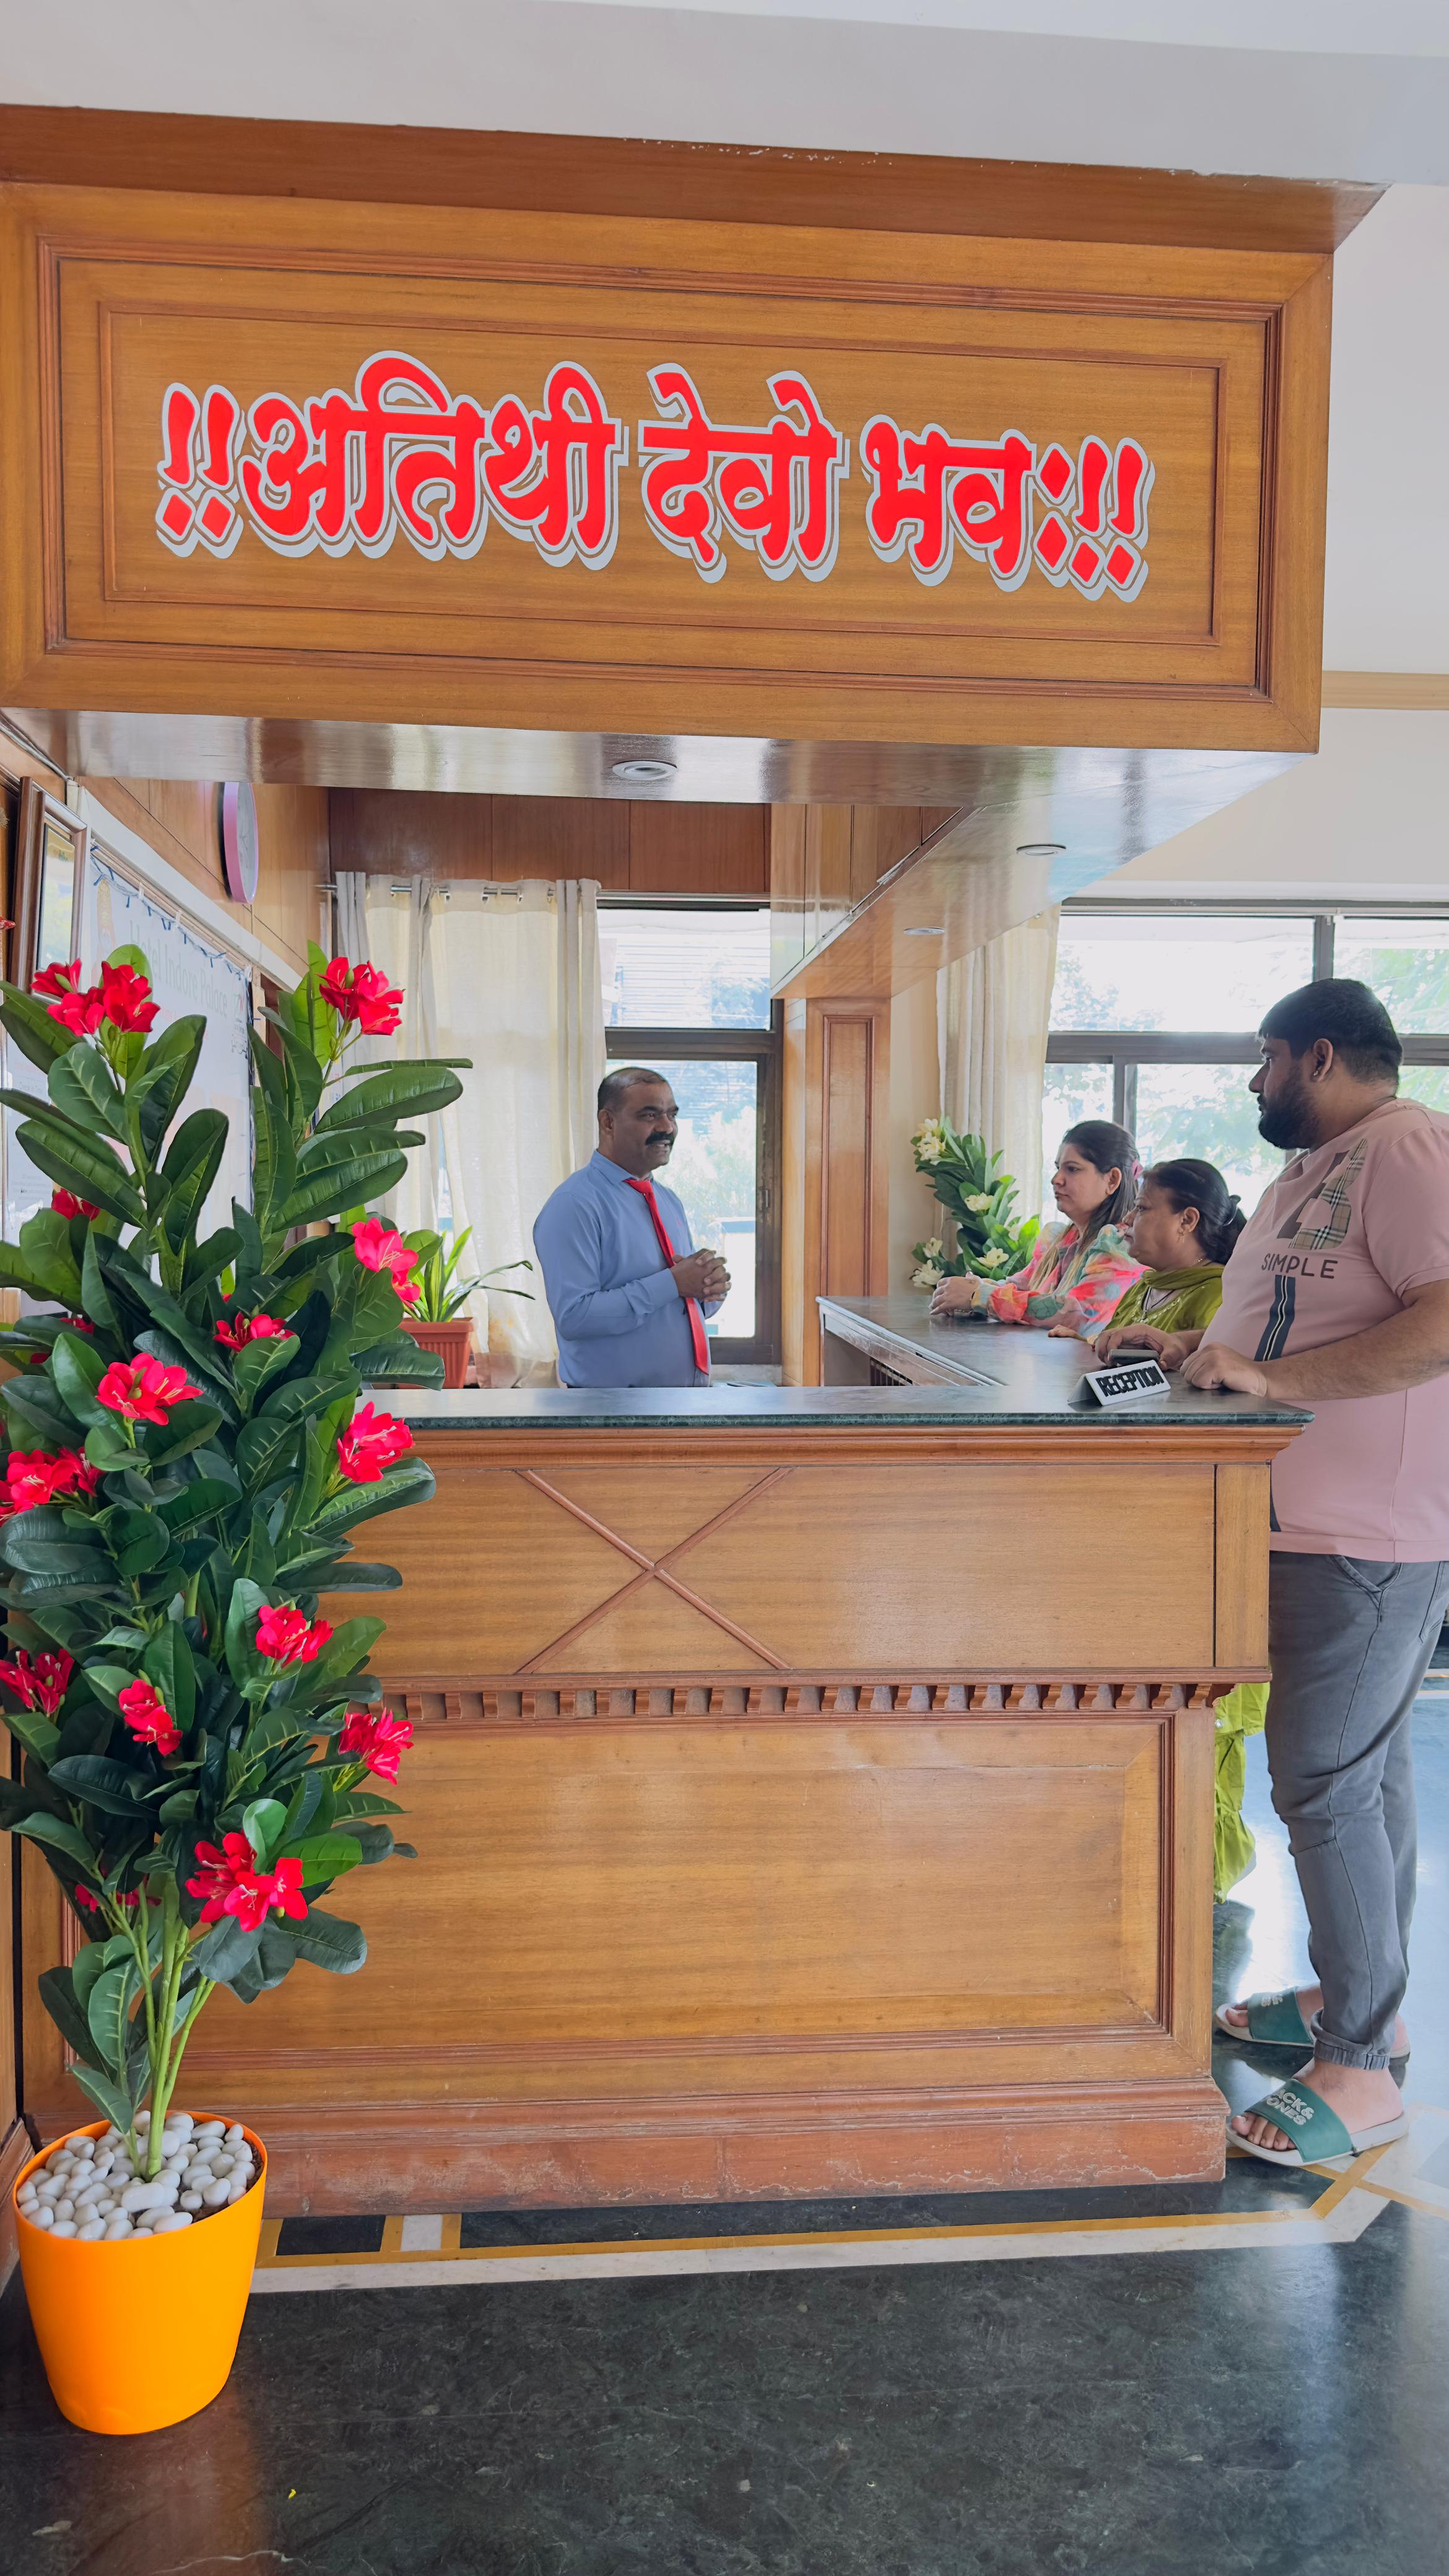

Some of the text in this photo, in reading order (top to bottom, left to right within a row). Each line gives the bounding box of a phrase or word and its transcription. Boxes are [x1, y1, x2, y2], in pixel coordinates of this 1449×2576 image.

[638, 365, 843, 568] देवो
[163, 944, 198, 1001] Indore
[199, 968, 227, 1019] Palace
[1261, 1253, 1339, 1279] SIMPLE
[1095, 1365, 1165, 1398] RECEPTION
[1266, 2097, 1307, 2125] ONES
